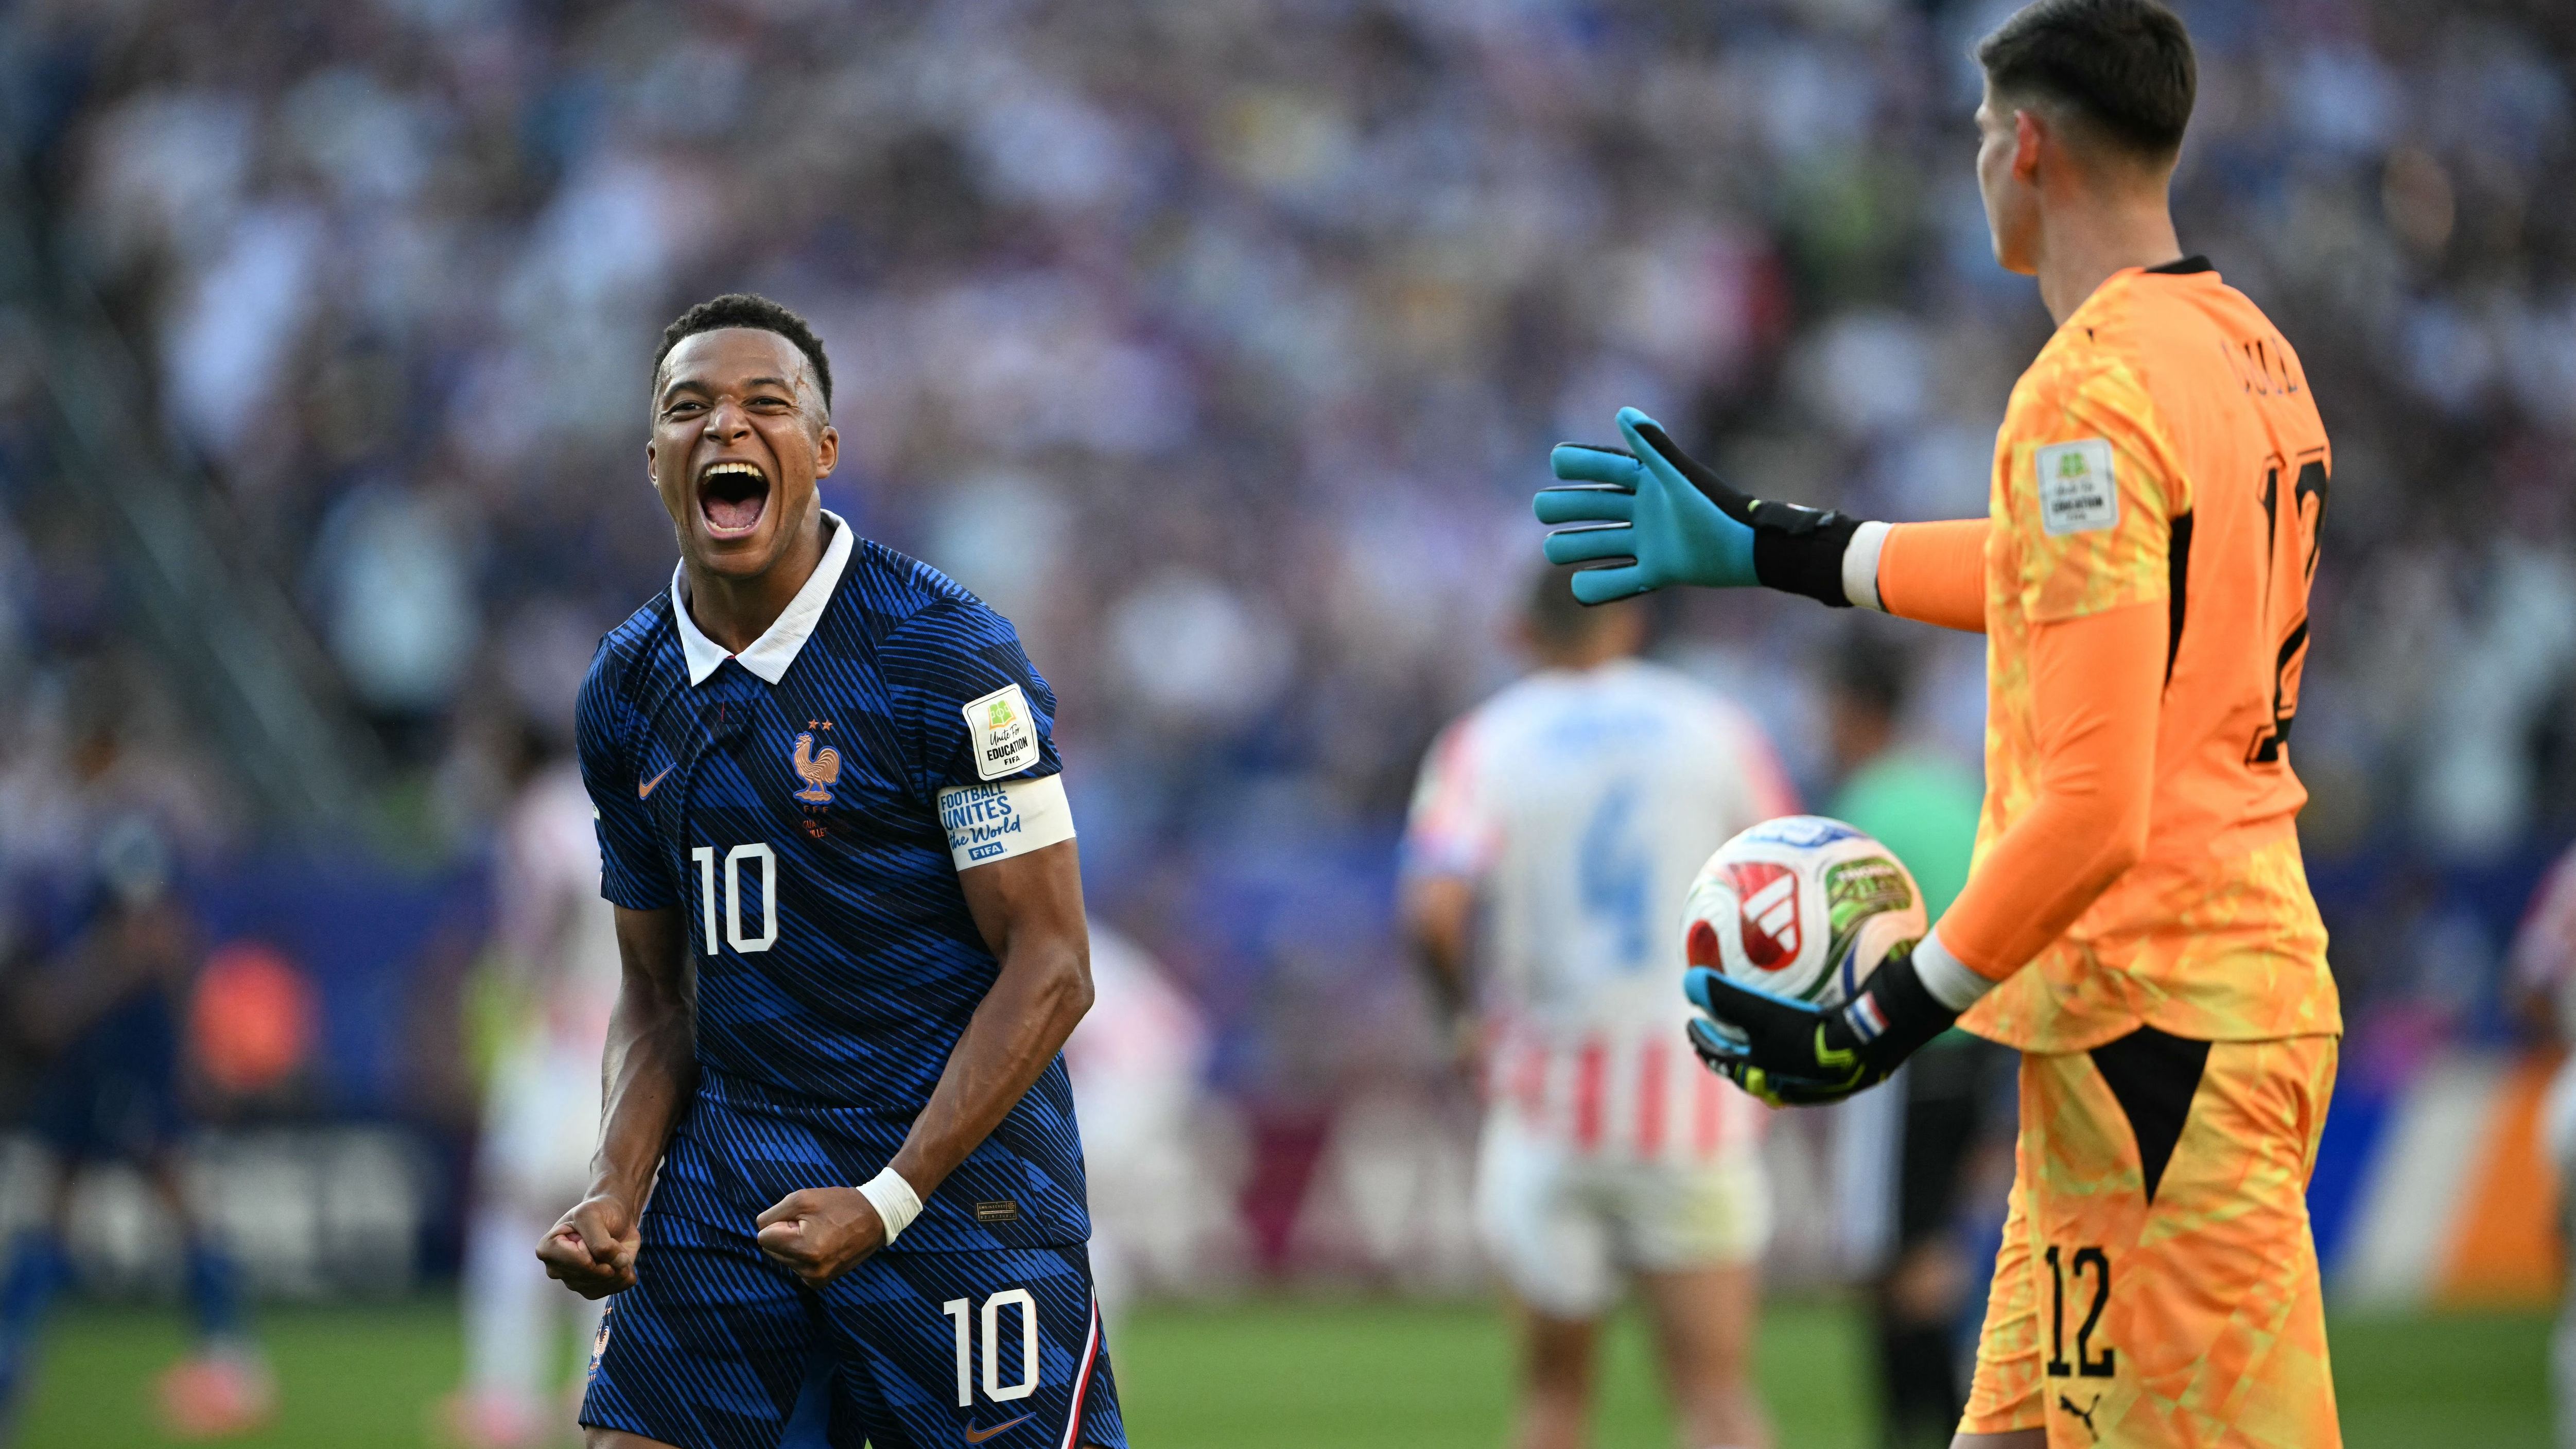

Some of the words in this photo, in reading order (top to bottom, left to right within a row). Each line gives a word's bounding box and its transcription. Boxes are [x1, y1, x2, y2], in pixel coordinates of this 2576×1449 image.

[987, 736, 1028, 761] EDUCATION
[990, 730, 1011, 746] Unite
[1010, 724, 1020, 738] For
[1004, 755, 1020, 765] FIFA
[940, 782, 1006, 810] FOOTBALL
[943, 795, 1012, 830] UNITES
[949, 831, 969, 850] the
[969, 814, 1021, 843] World
[971, 845, 1001, 858] FIFA
[692, 842, 777, 955] 10
[2045, 1245, 2114, 1377] 12
[943, 1288, 1040, 1407] 10
